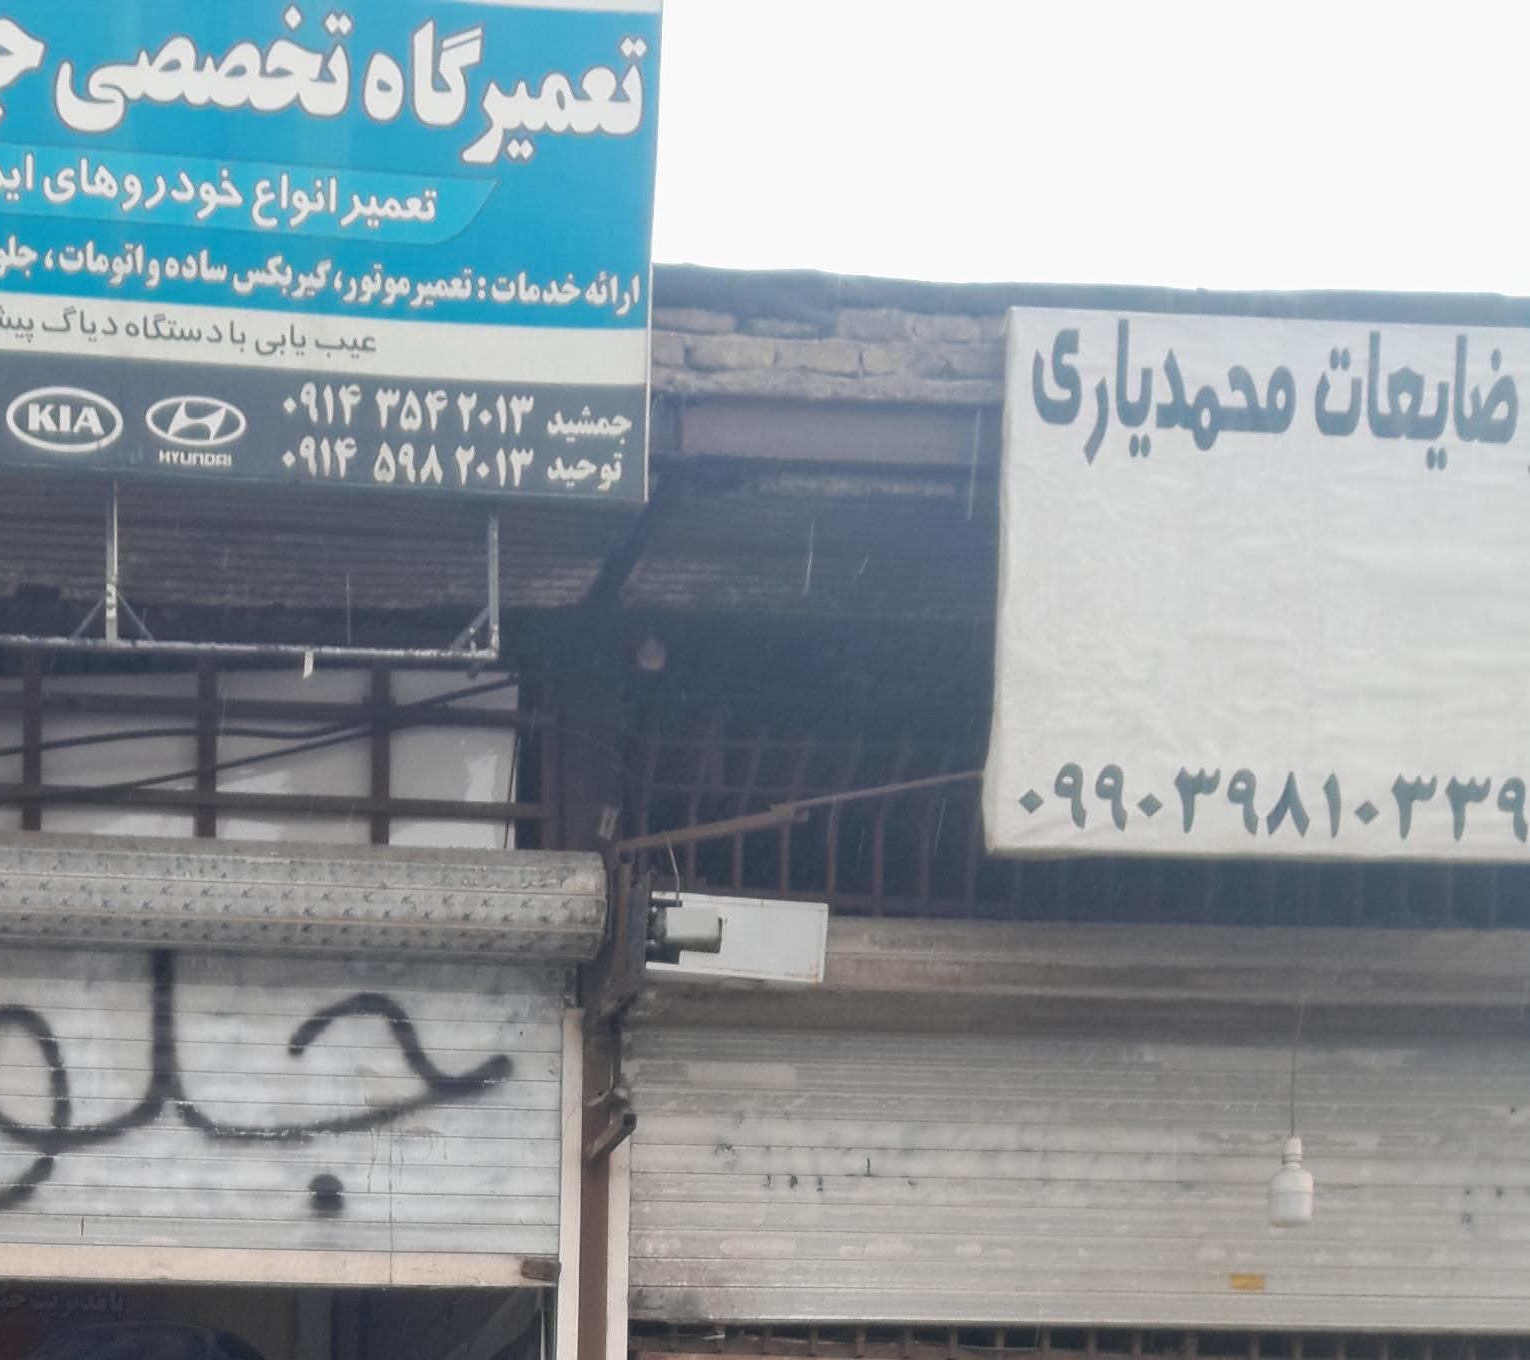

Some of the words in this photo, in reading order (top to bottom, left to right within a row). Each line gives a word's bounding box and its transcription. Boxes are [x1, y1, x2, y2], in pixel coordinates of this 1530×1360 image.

[54, 3, 351, 134] تخصصی
[361, 19, 650, 164] تعمیرگاه
[43, 157, 244, 220] خودروهای
[251, 172, 337, 227] انواع
[340, 189, 437, 227] تعمیر
[165, 249, 227, 284] ساده
[232, 254, 331, 298] گیربکس
[409, 267, 473, 307] تعمیر
[585, 271, 641, 316] ارائه
[41, 306, 118, 342] دیاگ
[125, 314, 223, 343] دستگاه
[229, 320, 246, 347] با
[255, 324, 306, 357] یابی
[315, 332, 377, 359] عیب
[28, 403, 104, 435] KIA
[283, 382, 362, 426] ۰۹۱۴
[375, 387, 448, 432] ۳۵۴
[457, 391, 534, 436] ۲۰۱۳
[1315, 330, 1519, 470] ضایعات
[546, 405, 632, 445] جمشید
[159, 450, 232, 467] HYUNDAI
[282, 435, 357, 479] ۰۹۱۴
[373, 441, 444, 485] ۵۹۸
[455, 444, 534, 488] ۲۰۱۳
[546, 452, 623, 491] توحید
